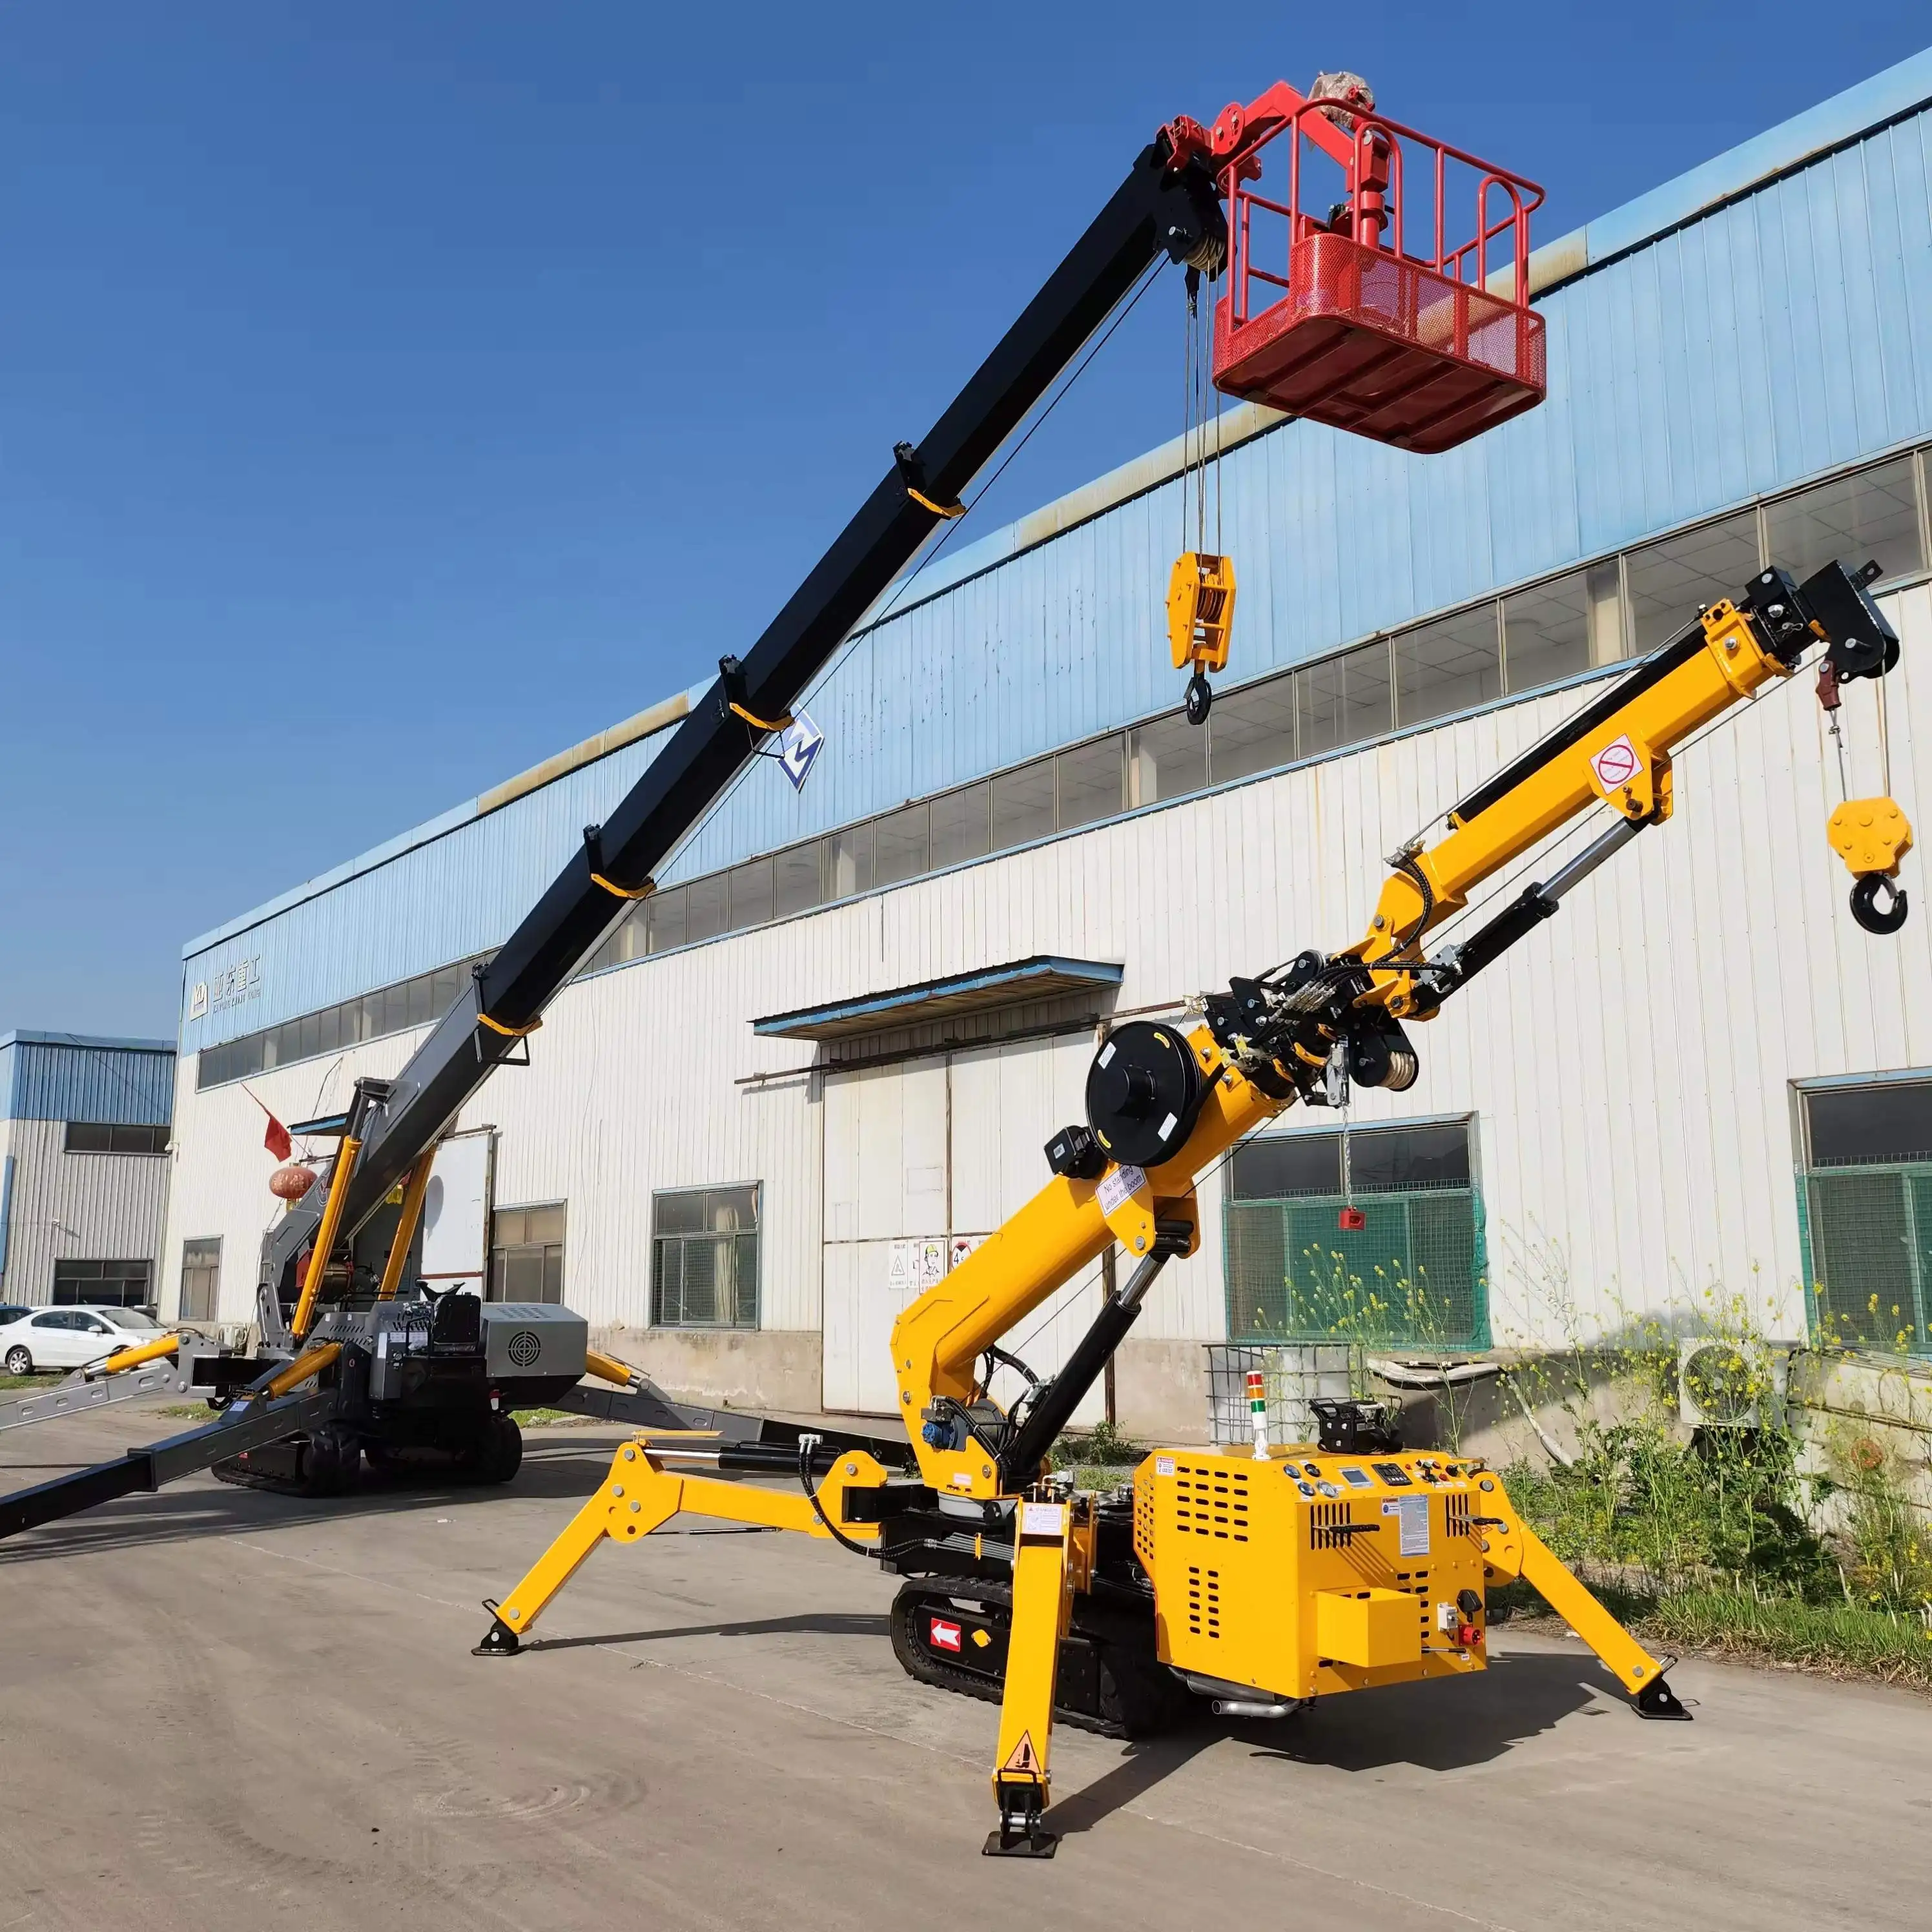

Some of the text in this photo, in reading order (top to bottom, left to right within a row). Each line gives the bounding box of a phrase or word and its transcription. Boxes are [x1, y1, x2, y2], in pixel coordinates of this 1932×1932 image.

[1103, 1165, 1134, 1194] No standing
[1104, 1175, 1142, 1211] under the boom
